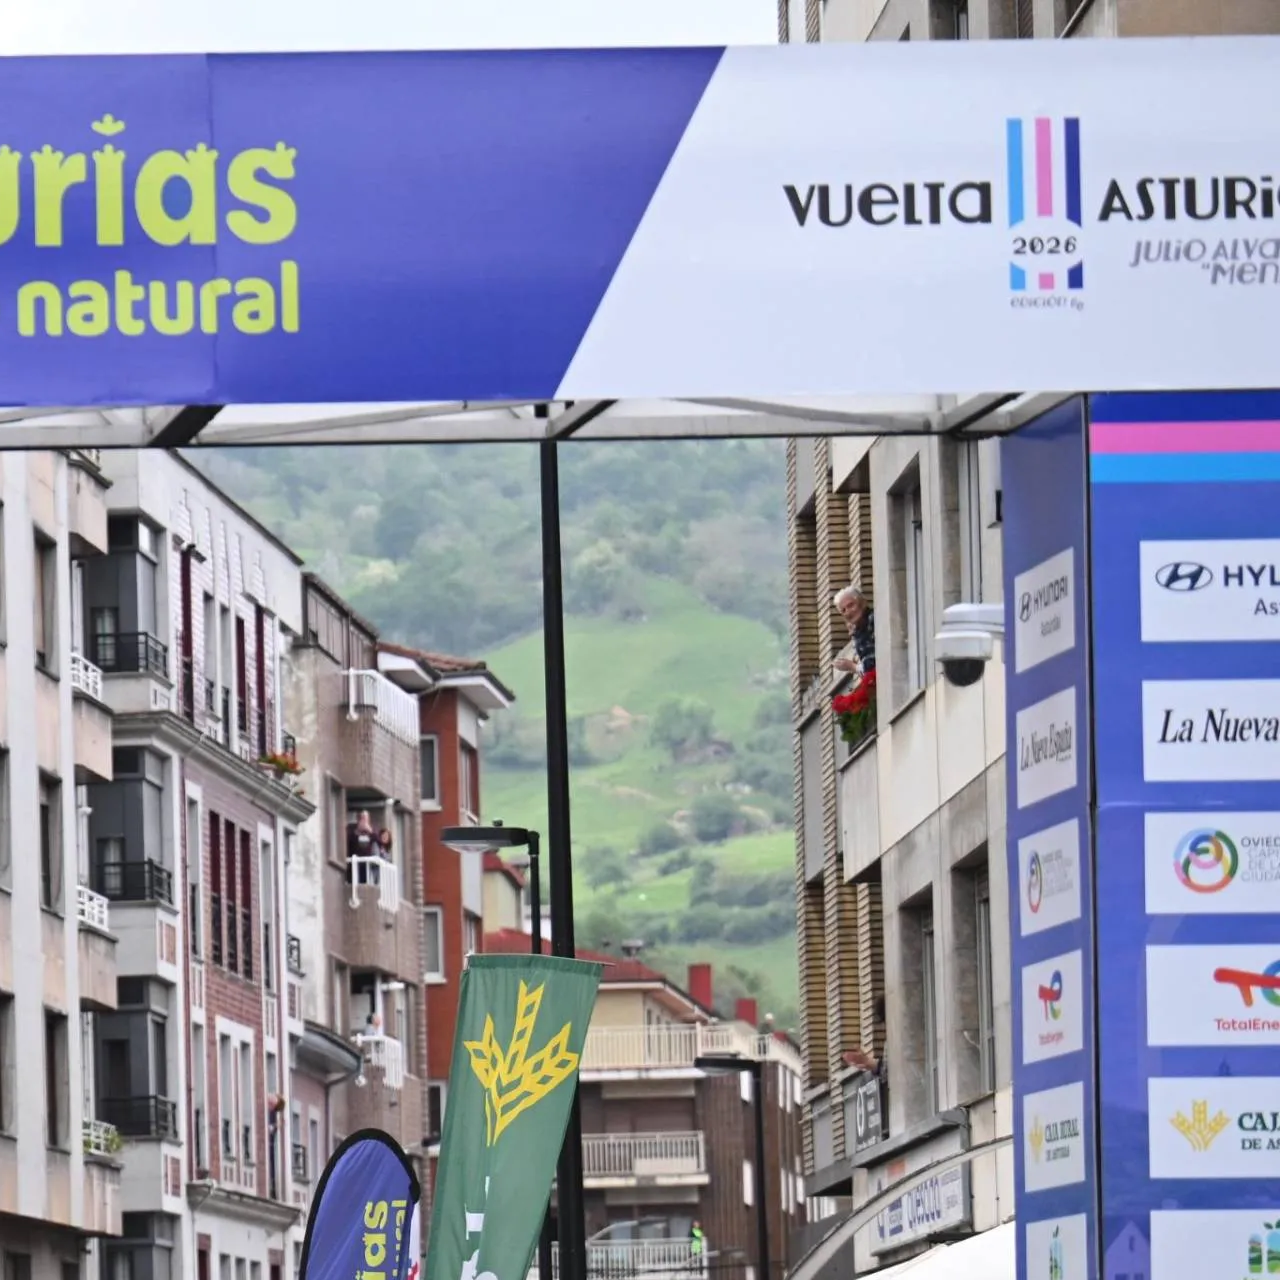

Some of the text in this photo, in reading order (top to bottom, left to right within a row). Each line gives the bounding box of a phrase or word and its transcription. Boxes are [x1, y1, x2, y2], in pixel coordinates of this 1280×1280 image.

[1013, 237, 1077, 255] 2026
[17, 260, 299, 338] natural
[1158, 709, 1193, 744] La
